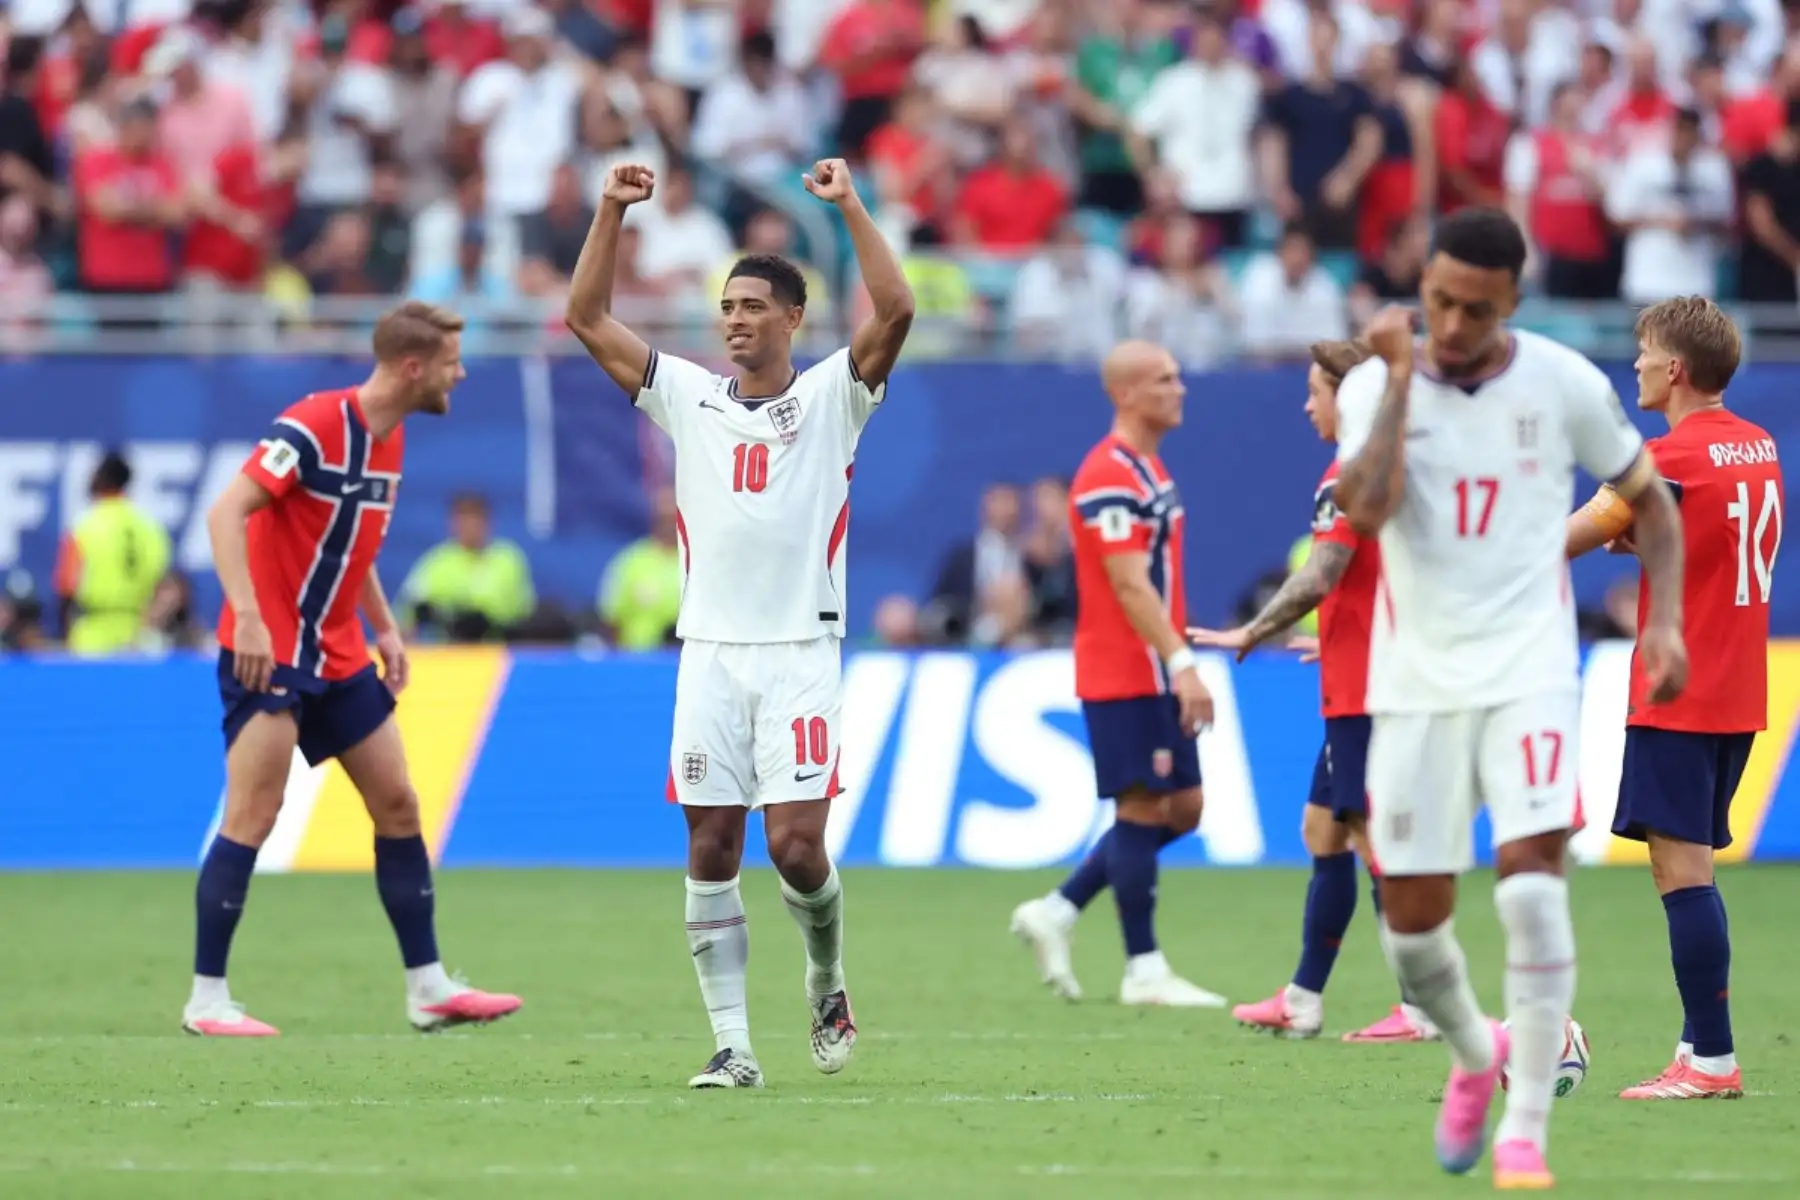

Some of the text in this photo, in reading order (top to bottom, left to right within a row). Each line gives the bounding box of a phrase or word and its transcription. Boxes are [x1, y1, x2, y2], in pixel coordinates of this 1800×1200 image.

[733, 443, 769, 492] 10
[1453, 476, 1499, 538] 17
[1727, 480, 1782, 606] 10
[791, 716, 828, 765] 10
[1520, 730, 1563, 787] 17
